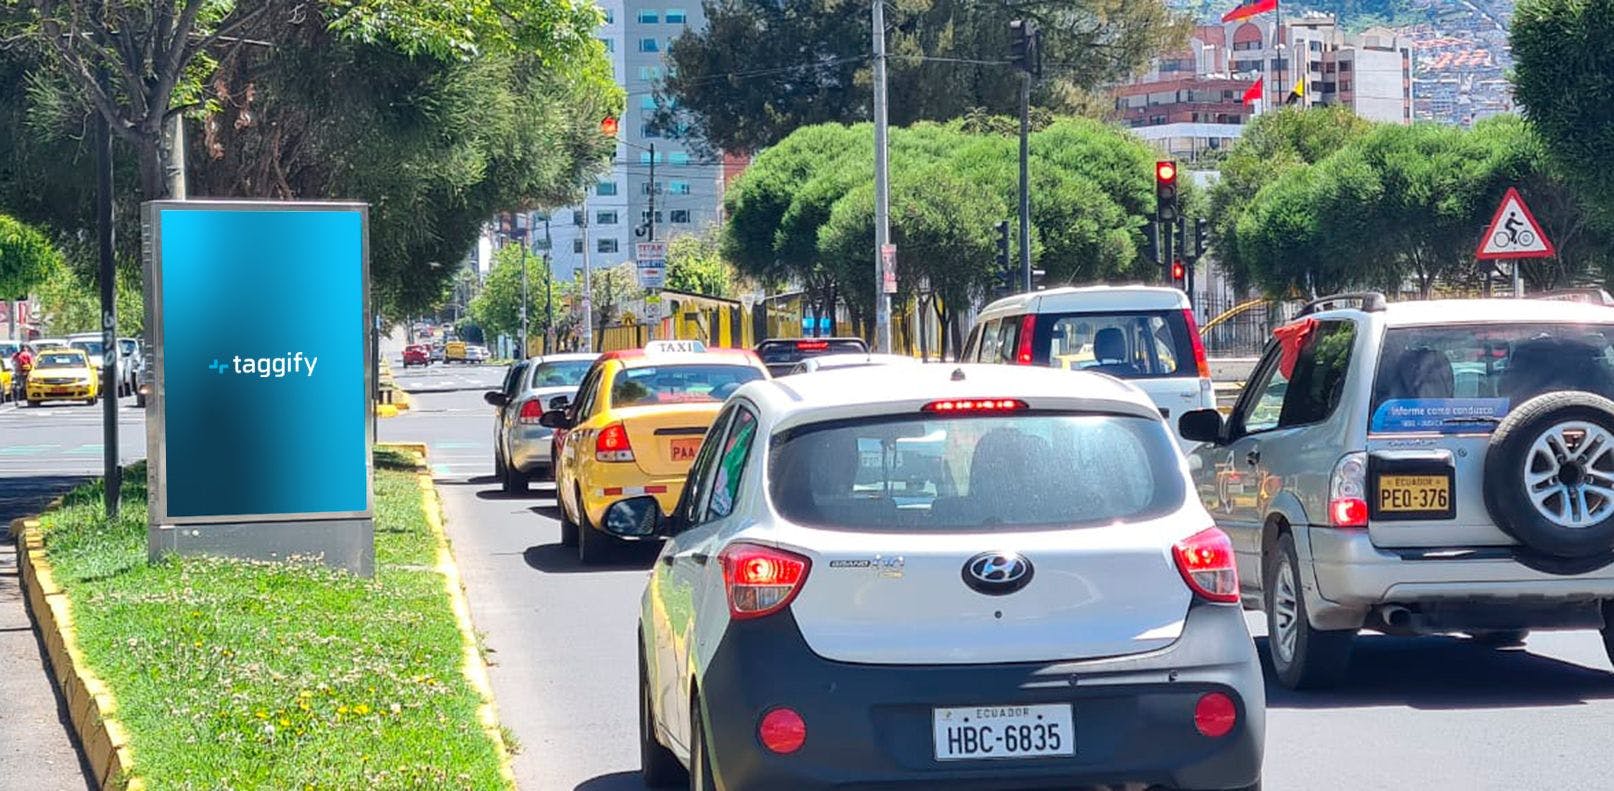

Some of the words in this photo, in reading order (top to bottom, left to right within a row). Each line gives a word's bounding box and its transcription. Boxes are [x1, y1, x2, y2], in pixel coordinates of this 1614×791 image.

[658, 342, 692, 352] TAXI
[232, 352, 318, 378] taggify
[673, 447, 695, 458] PAA
[1395, 478, 1432, 487] ECUADOR
[977, 708, 1029, 719] ECUADOR
[948, 724, 1060, 754] HBC-6835
